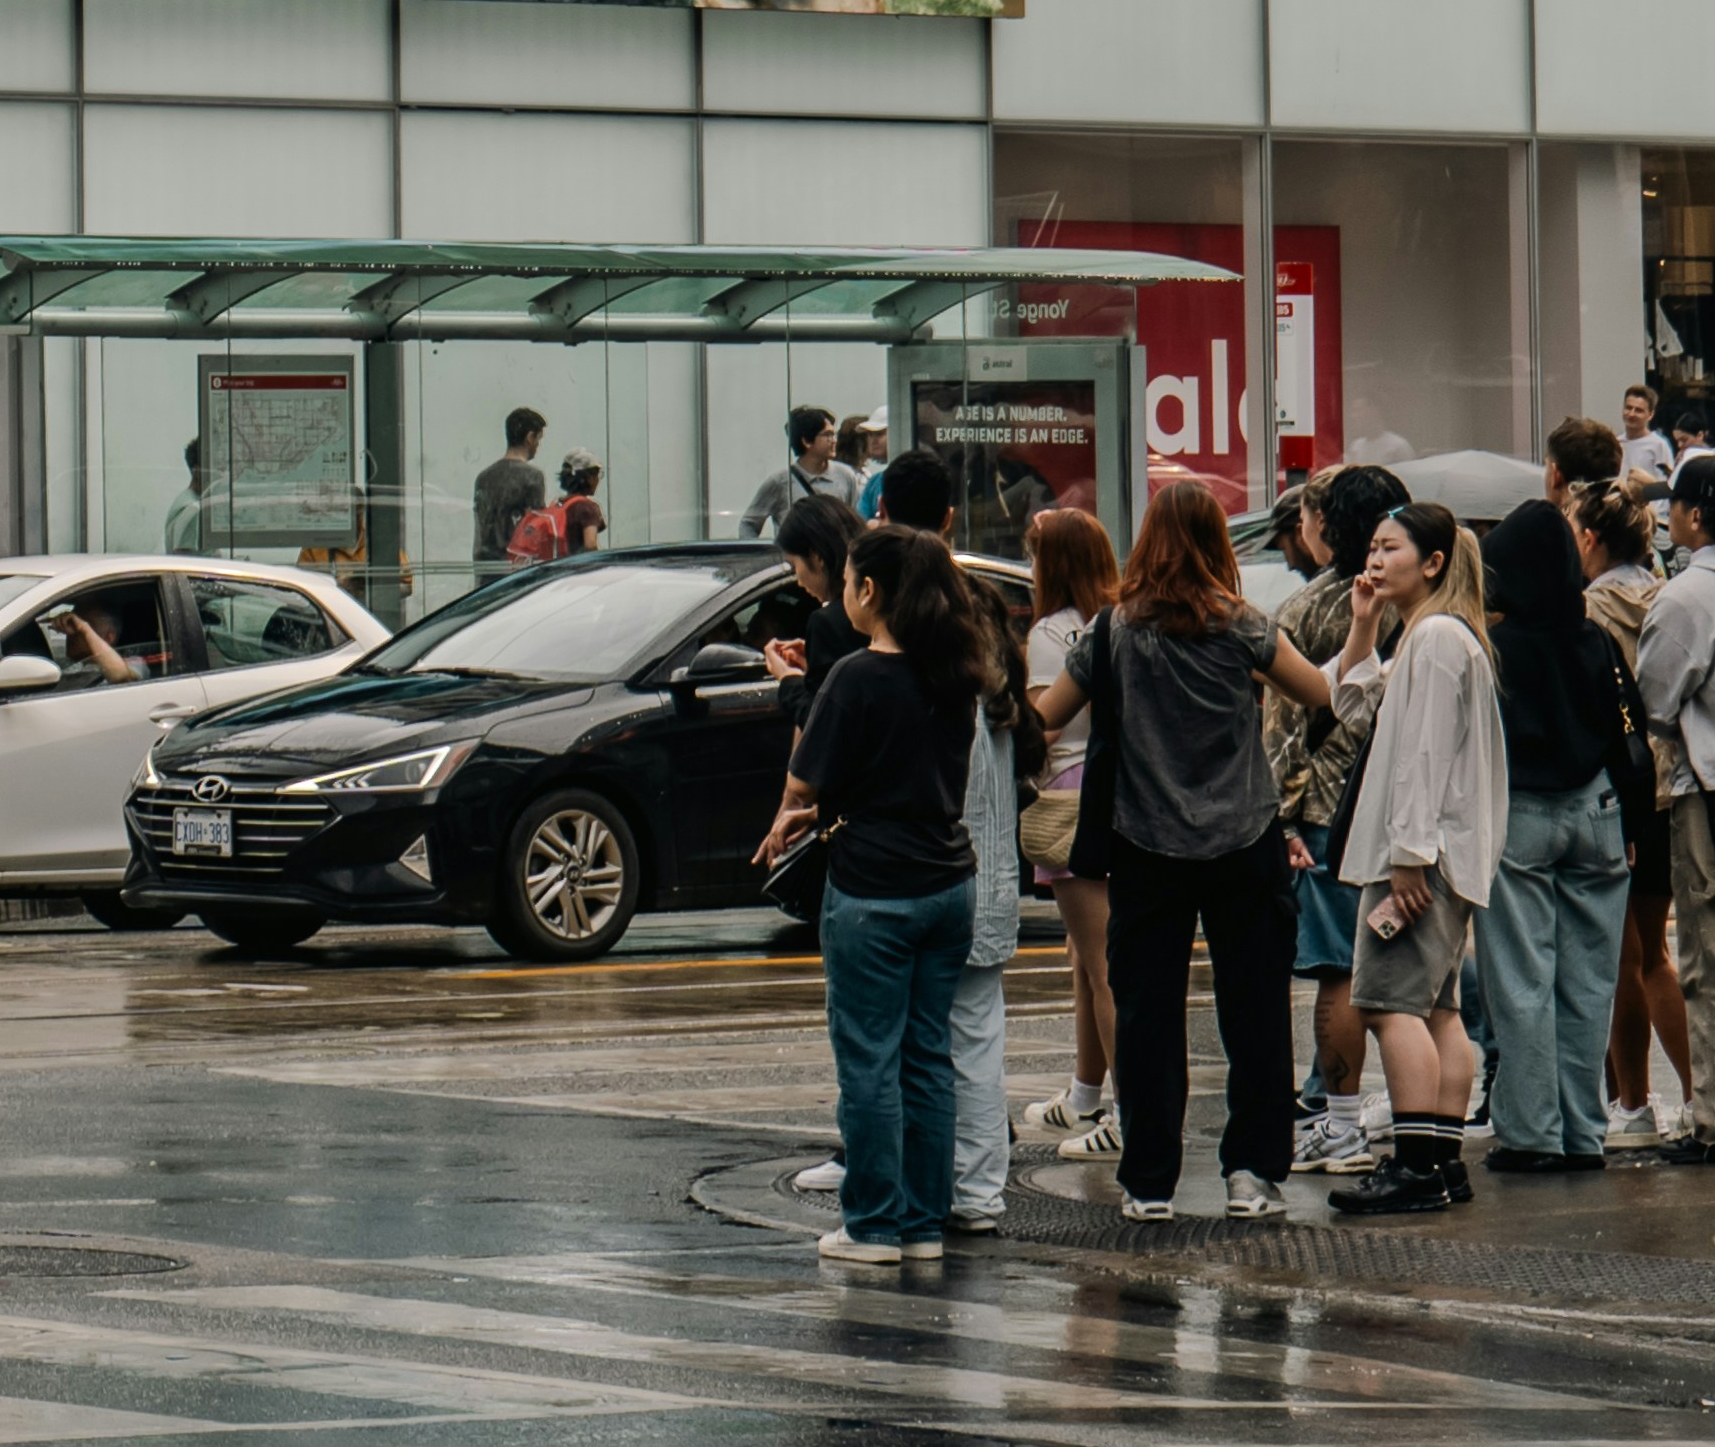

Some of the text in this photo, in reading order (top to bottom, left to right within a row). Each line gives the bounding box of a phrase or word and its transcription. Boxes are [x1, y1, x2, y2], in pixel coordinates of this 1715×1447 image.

[1146, 339, 1248, 456] al
[982, 407, 994, 421] IS
[997, 407, 1006, 421] A
[1009, 407, 1067, 422] NUMBER.
[936, 427, 1088, 444] EXPERIENCE IS AN EDGE.
[209, 822, 230, 844] 383
